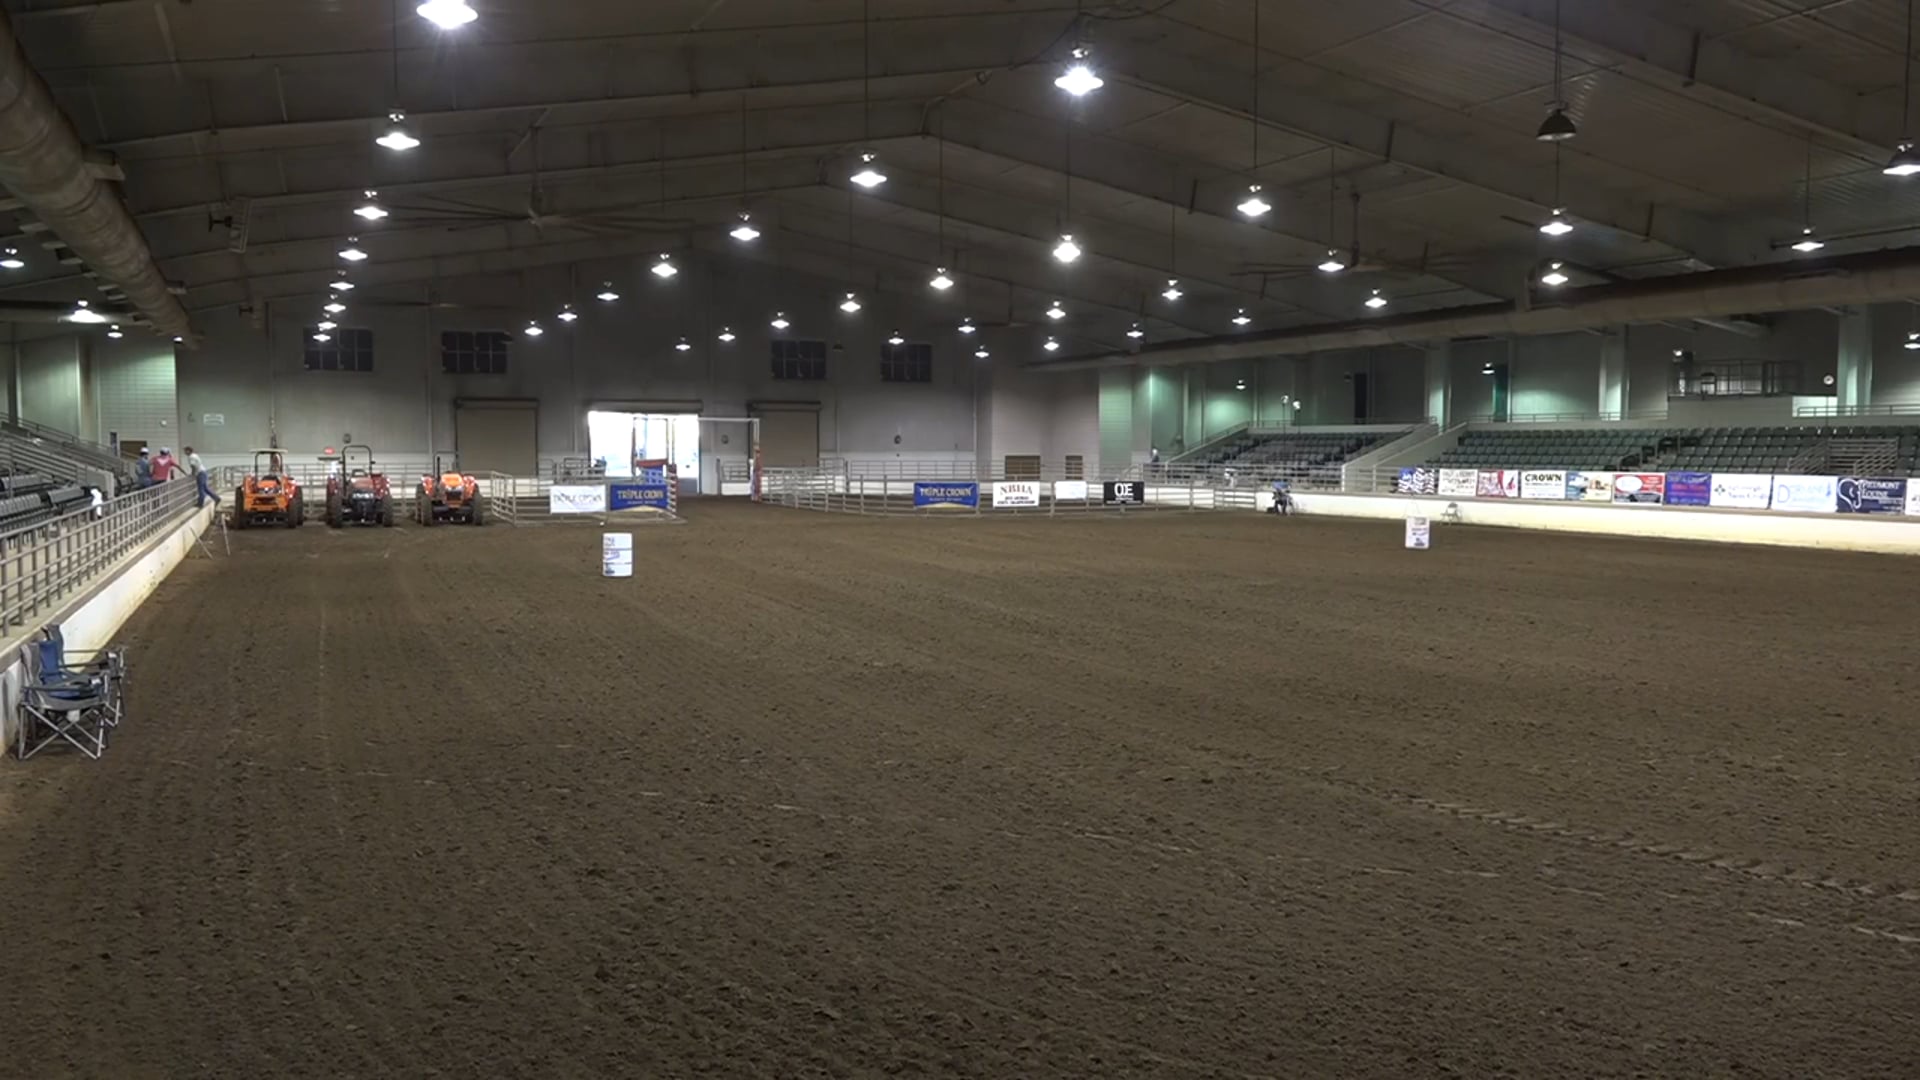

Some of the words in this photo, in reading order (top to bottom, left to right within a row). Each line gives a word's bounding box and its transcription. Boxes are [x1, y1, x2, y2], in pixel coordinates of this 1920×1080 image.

[1525, 473, 1562, 482] CROWN
[617, 489, 642, 500] TRIPLE
[643, 490, 664, 500] CROWN
[920, 487, 945, 497] TRIPLE
[946, 487, 972, 497] CROWN
[1000, 484, 1033, 495] NBHA
